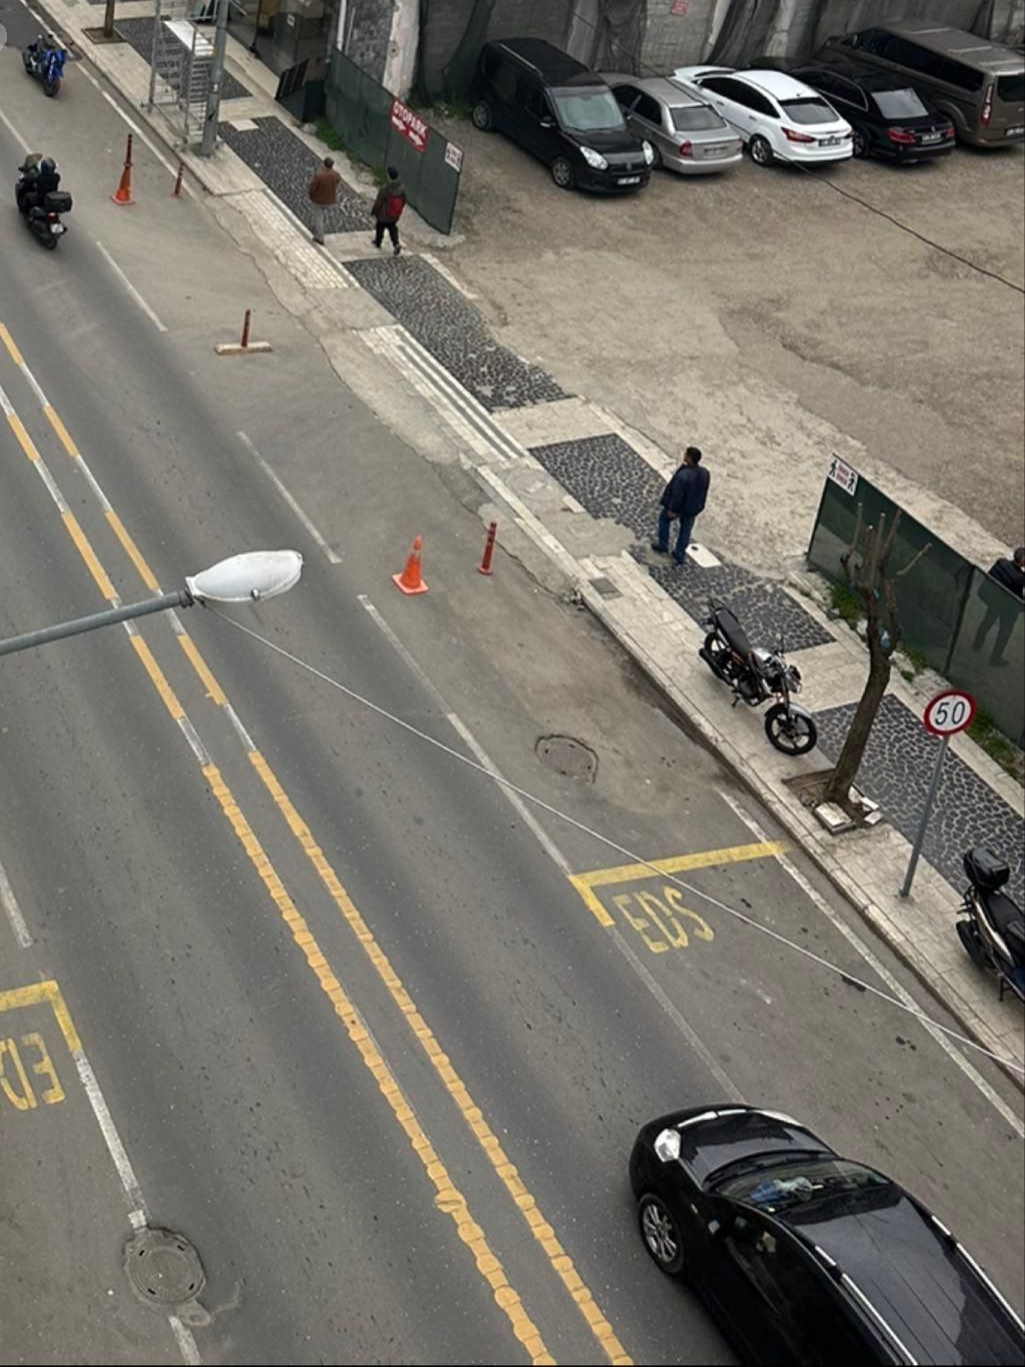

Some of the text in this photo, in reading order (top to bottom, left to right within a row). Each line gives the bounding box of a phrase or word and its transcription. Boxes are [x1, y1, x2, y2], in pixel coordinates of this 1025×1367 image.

[392, 100, 428, 139] OTOPARK
[935, 701, 966, 726] 50
[612, 884, 715, 954] EDS
